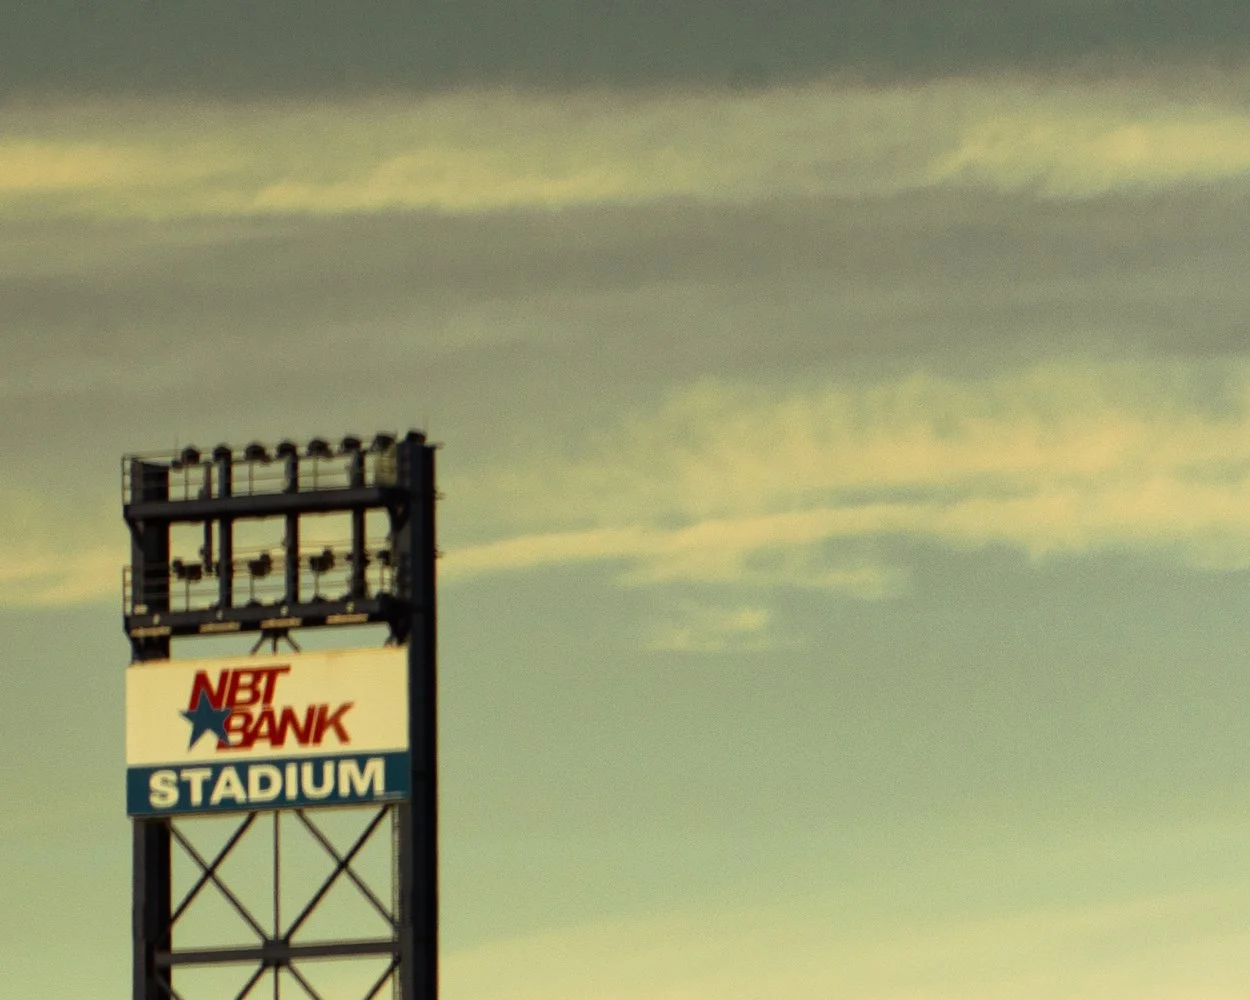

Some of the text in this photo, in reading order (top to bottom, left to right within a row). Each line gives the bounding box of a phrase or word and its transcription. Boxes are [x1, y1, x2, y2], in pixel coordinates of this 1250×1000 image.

[189, 664, 290, 711] NBT
[216, 701, 355, 753] BANK
[149, 756, 386, 810] STADIUM
